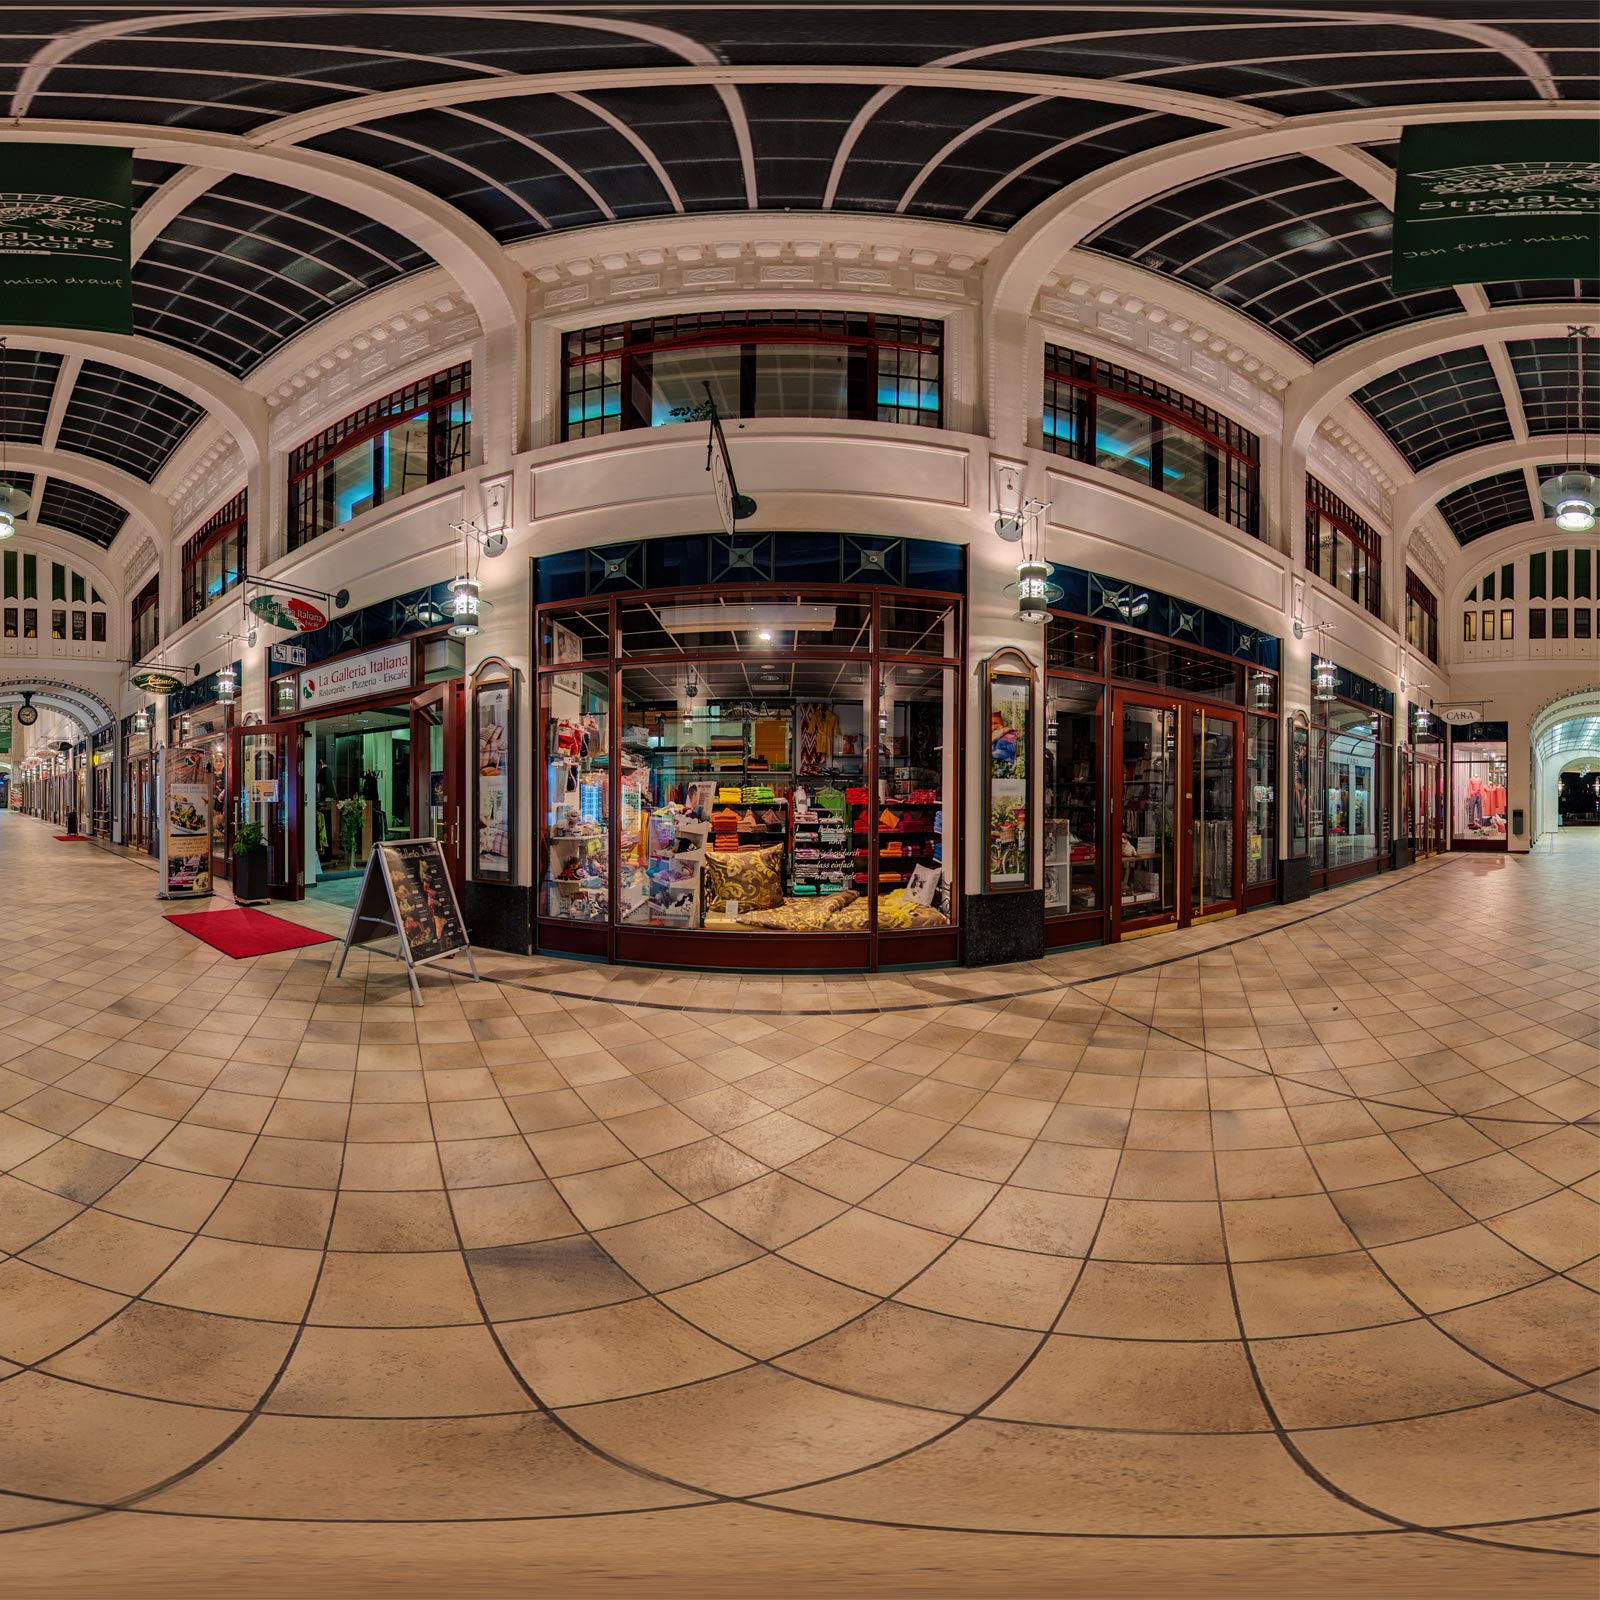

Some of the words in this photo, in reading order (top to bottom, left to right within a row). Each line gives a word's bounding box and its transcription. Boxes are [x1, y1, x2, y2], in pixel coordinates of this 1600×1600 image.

[72, 215, 123, 226] 1908
[3, 276, 58, 286] mich
[64, 276, 124, 289] drauf
[297, 609, 323, 622] Italiana
[318, 675, 329, 687] La
[331, 664, 367, 684] Galleria
[370, 655, 409, 674] Italiana
[318, 684, 347, 697] Ristorante
[351, 677, 377, 690] Pizzeria
[383, 668, 409, 683] Eiscafé
[708, 701, 773, 720] CARA
[1446, 711, 1476, 721] CARA
